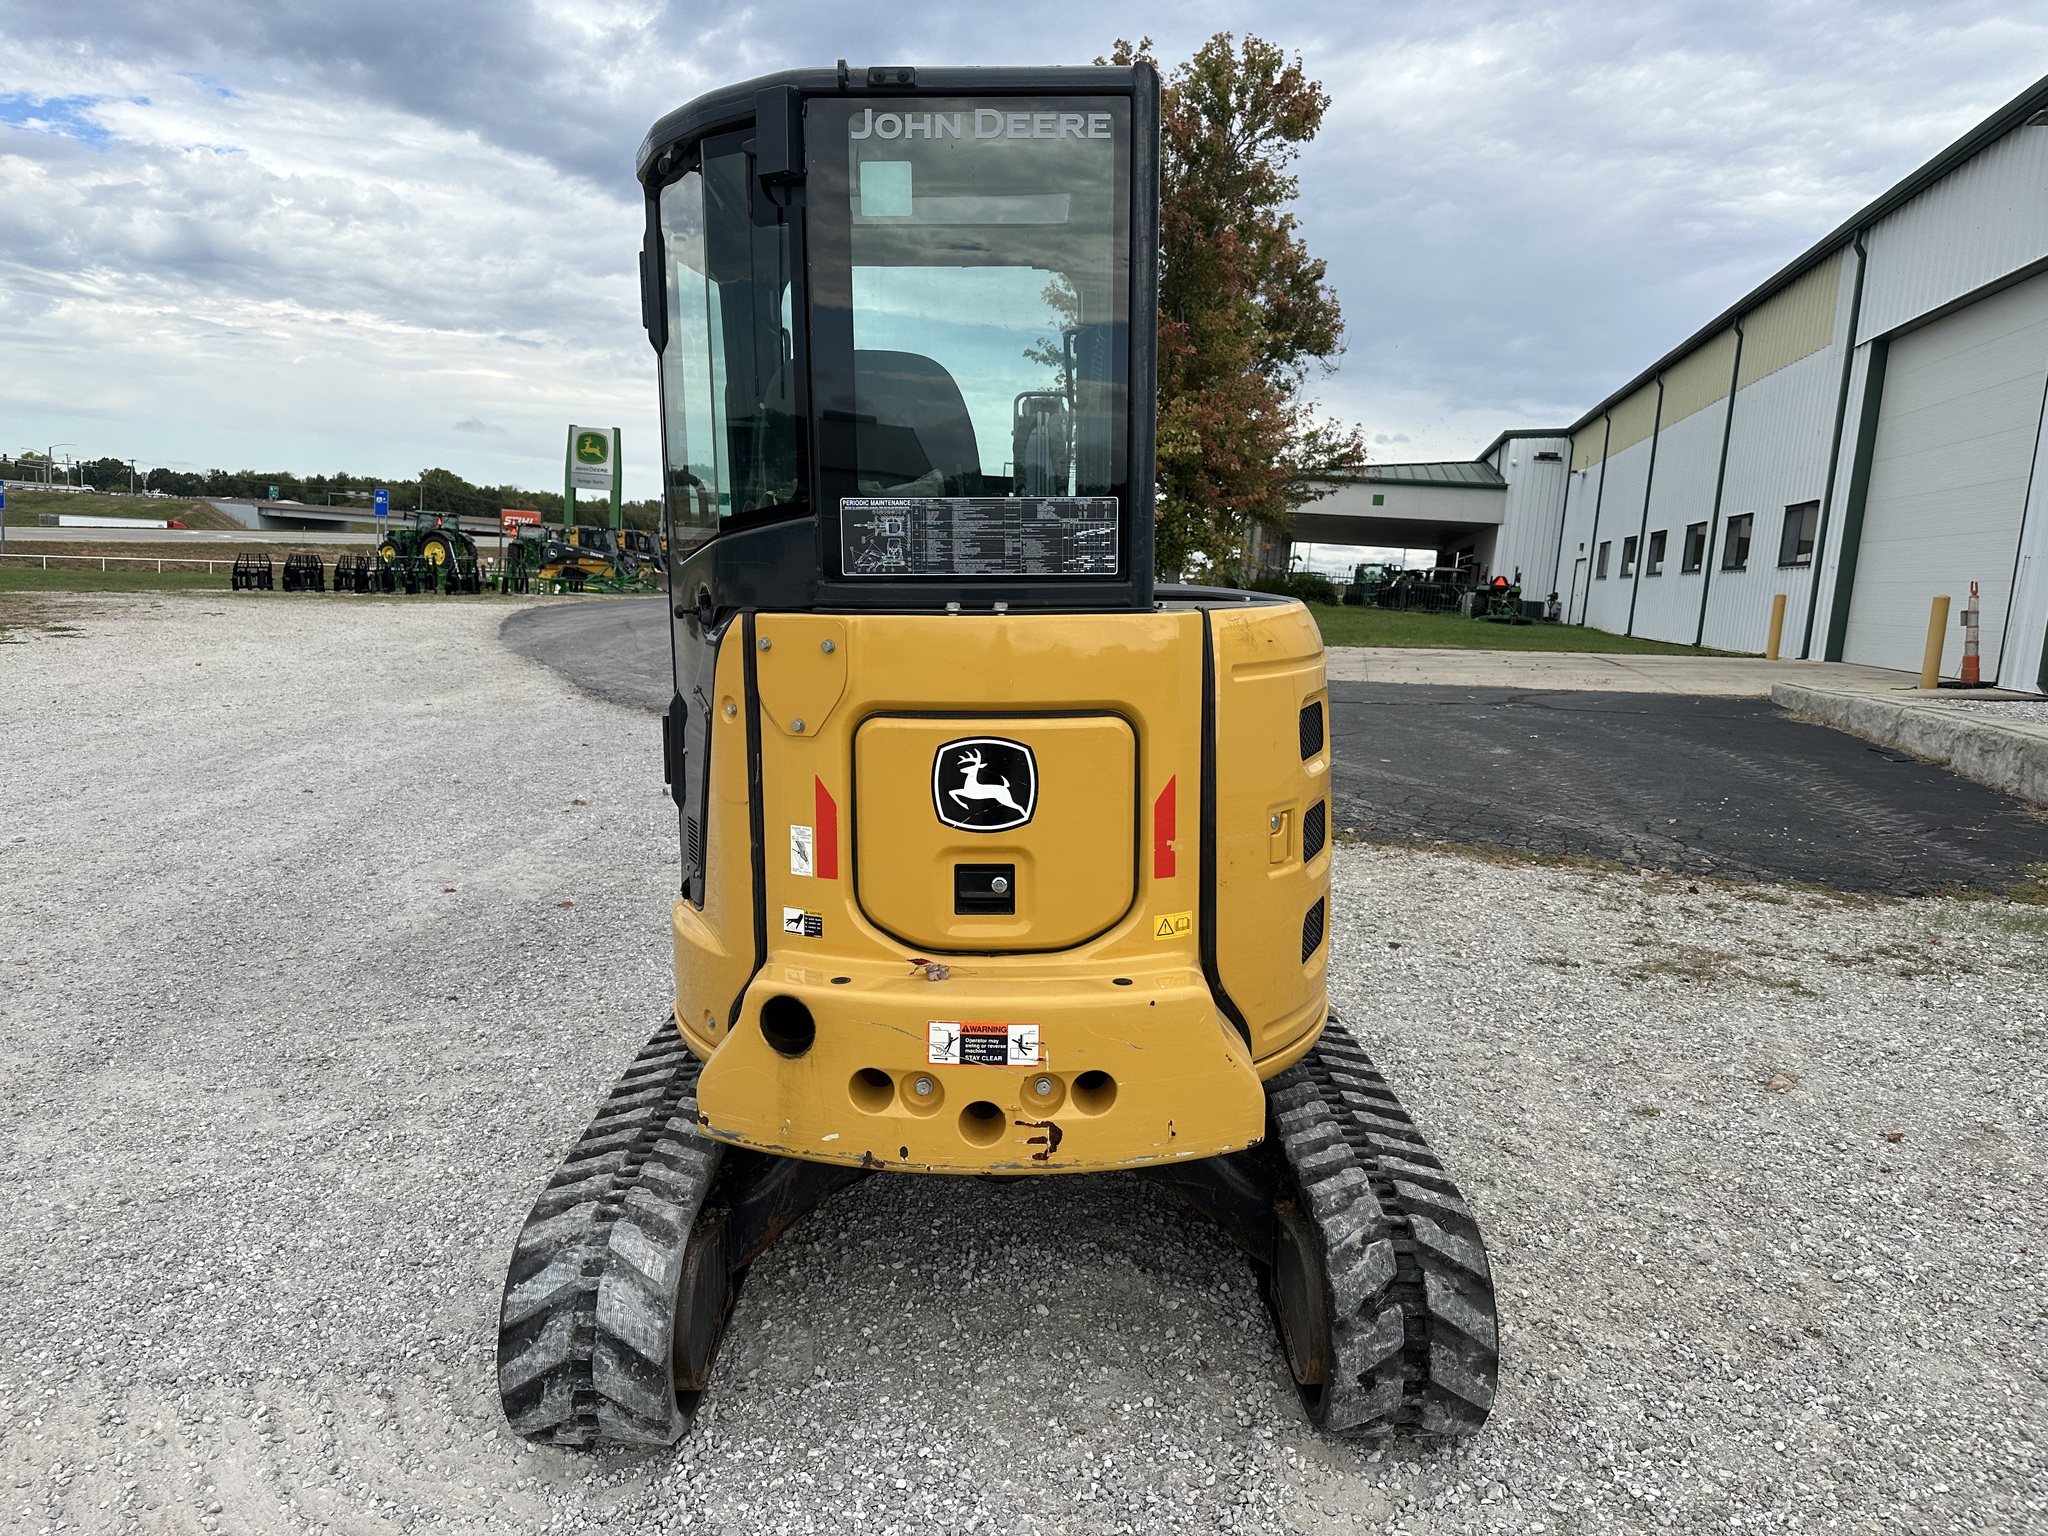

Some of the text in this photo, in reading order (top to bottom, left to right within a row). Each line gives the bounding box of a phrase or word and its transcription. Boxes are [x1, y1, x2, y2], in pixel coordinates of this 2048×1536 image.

[851, 108, 1112, 140] JOHN DEERE
[589, 466, 609, 474] DEERE
[969, 1025, 1007, 1034] WARNING
